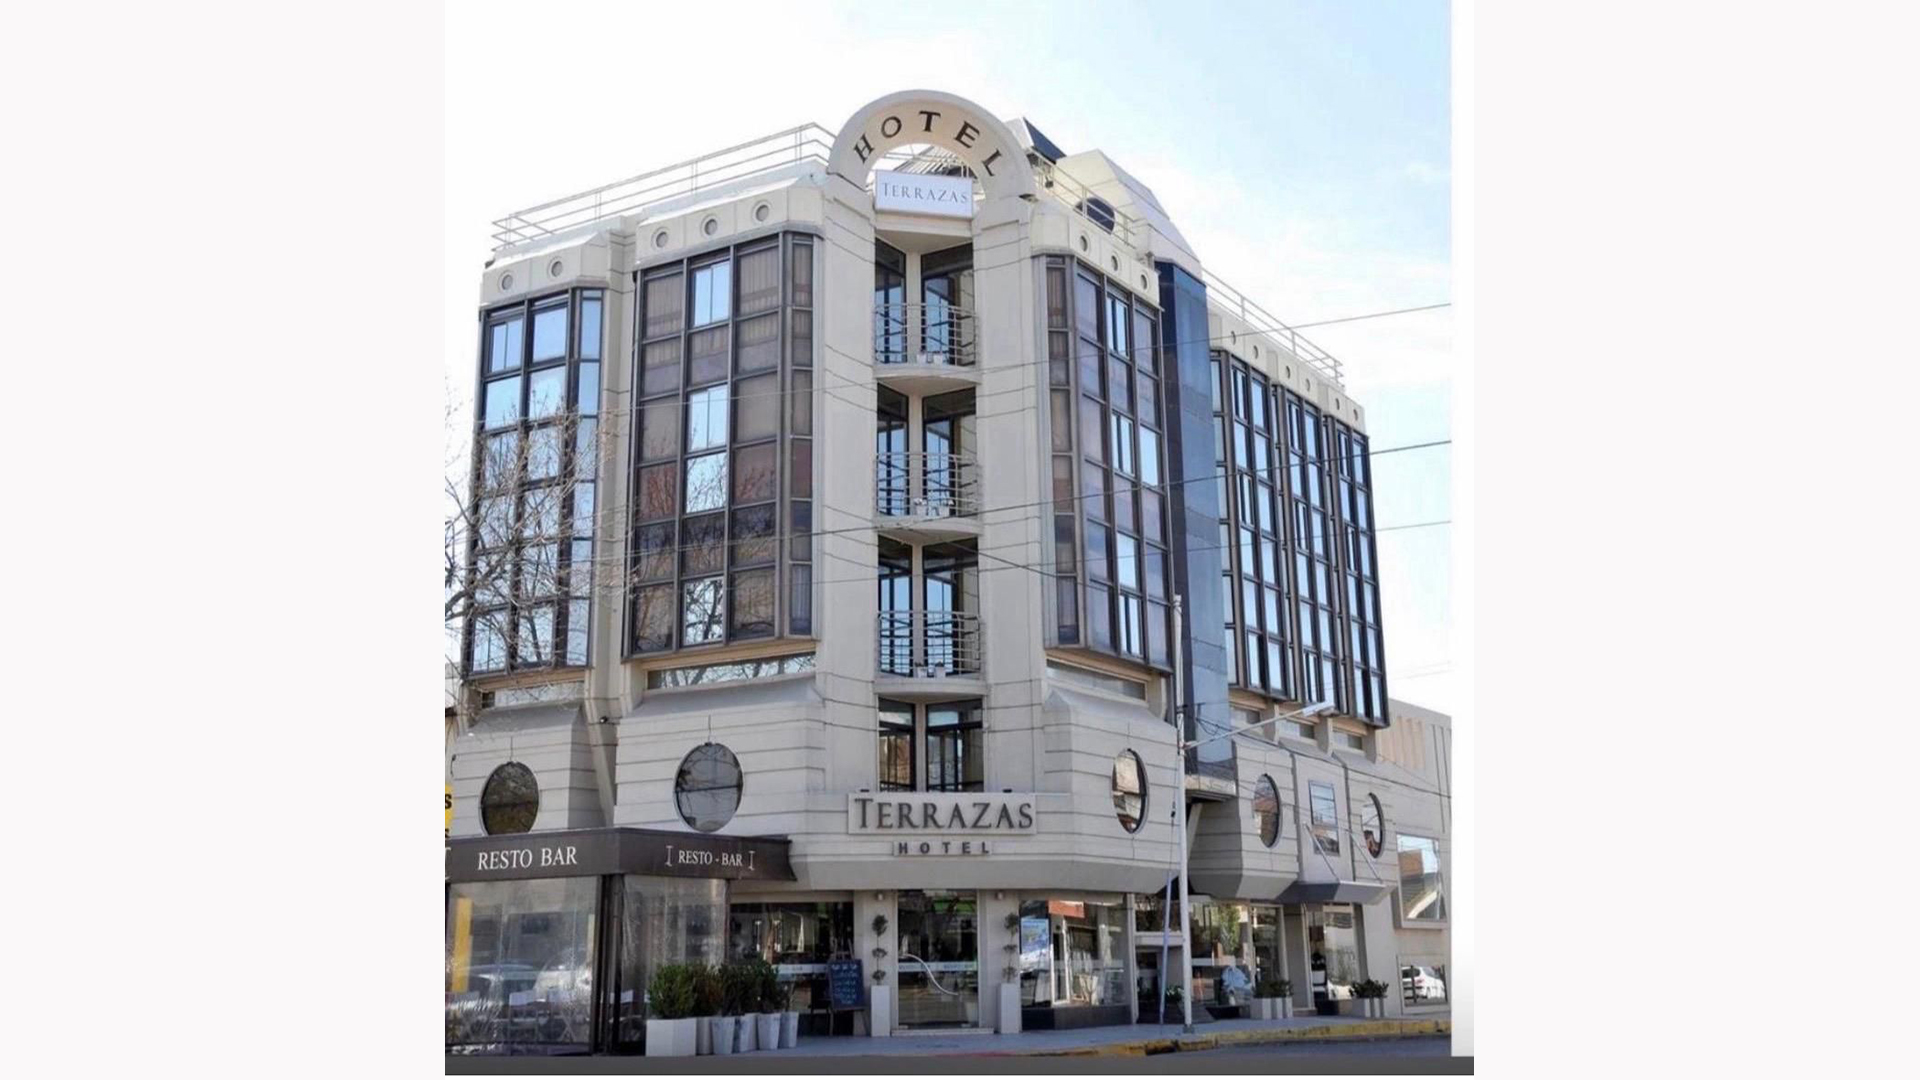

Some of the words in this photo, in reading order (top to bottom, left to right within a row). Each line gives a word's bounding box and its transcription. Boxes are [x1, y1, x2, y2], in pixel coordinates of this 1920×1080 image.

[853, 110, 1002, 176] HOTEL
[881, 182, 968, 204] TERRAZAS
[854, 798, 1034, 830] TERRAZAS
[477, 849, 533, 871] RESTO
[541, 846, 578, 867] BAR
[678, 850, 713, 865] RESTO
[721, 852, 743, 867] BAR
[898, 841, 990, 855] HOTEL
